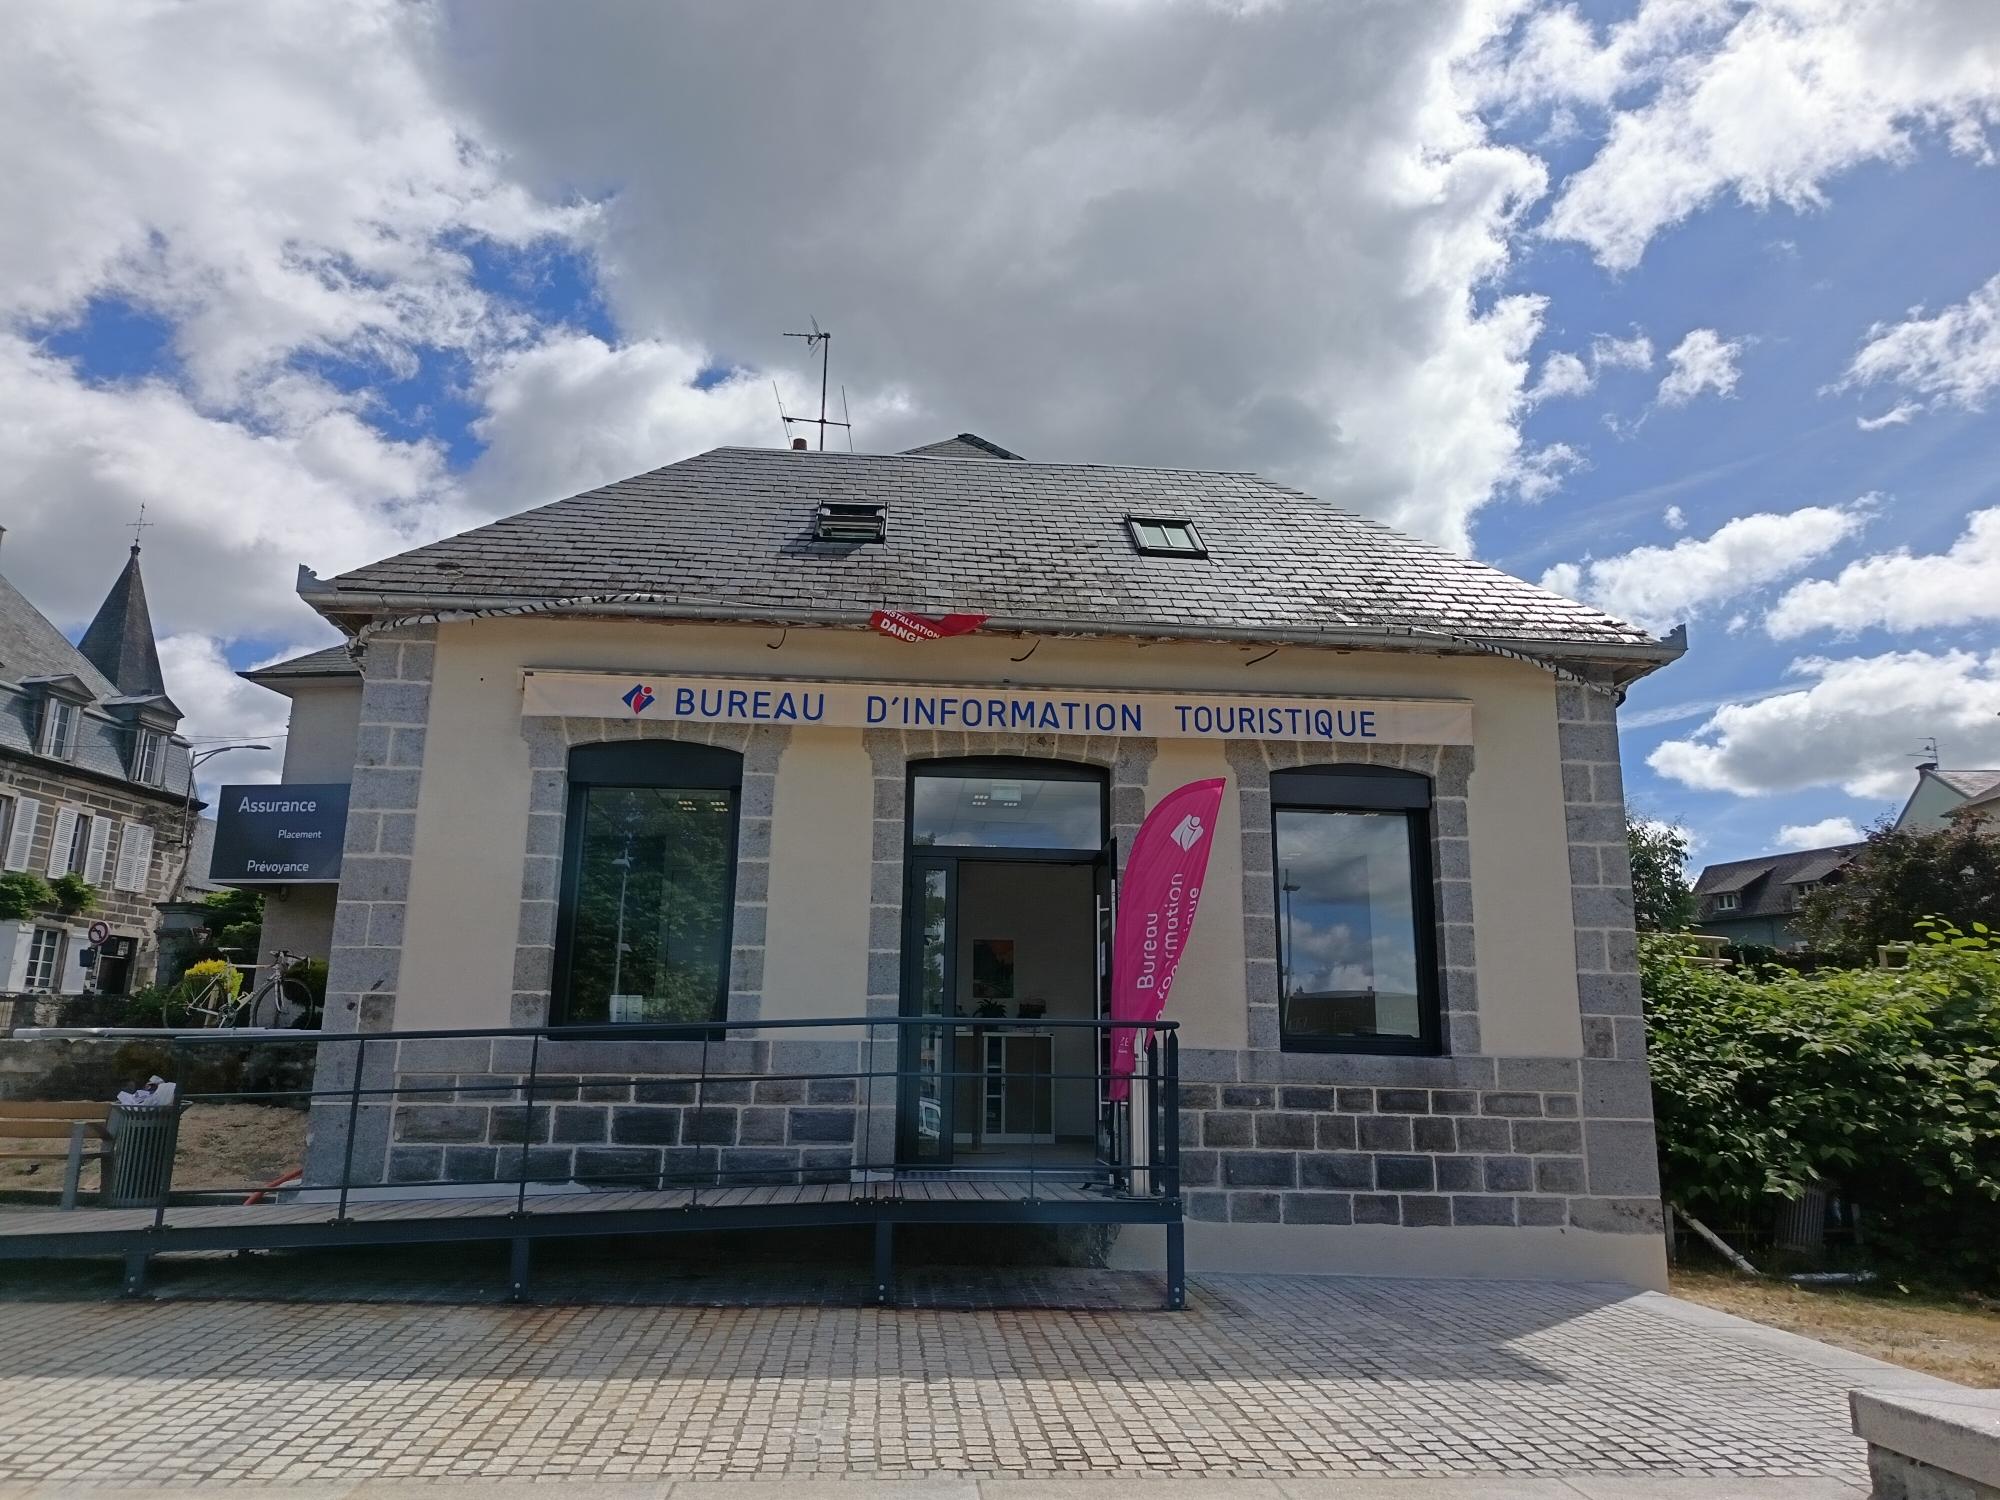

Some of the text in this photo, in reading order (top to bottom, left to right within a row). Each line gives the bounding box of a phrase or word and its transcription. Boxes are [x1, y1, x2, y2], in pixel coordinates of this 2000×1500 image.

[675, 687, 1377, 739] BUREAU D'INFORMATION TOURISTIQUE
[238, 796, 317, 813] Assurance
[278, 829, 322, 839] Placement
[246, 860, 310, 875] Prévoyance
[1136, 913, 1159, 989] Bureau
